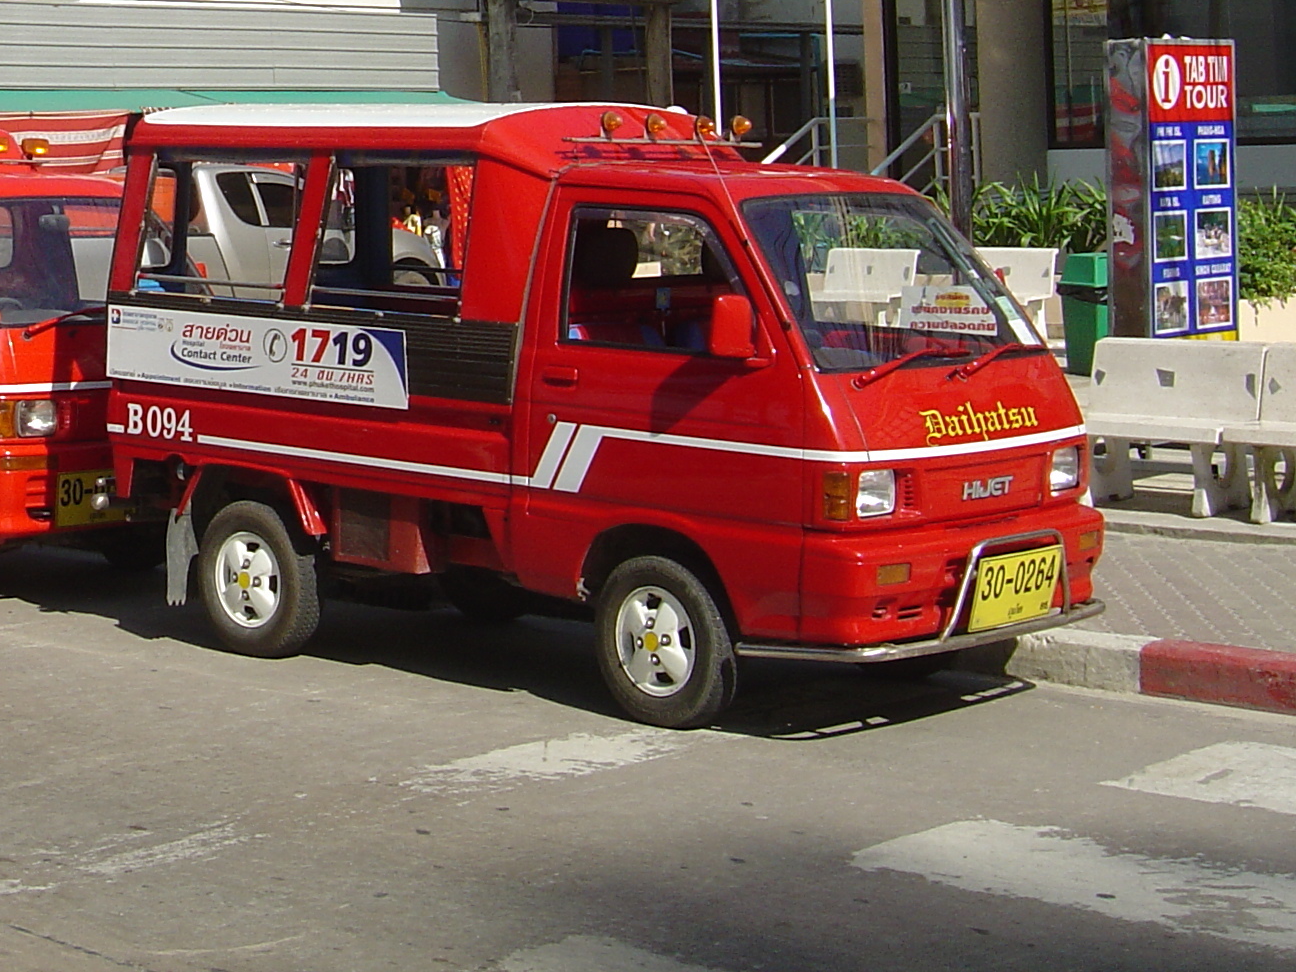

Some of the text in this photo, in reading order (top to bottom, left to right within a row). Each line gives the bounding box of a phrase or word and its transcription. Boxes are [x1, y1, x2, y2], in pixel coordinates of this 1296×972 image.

[1184, 55, 1228, 83] TAB TIM
[1184, 85, 1228, 109] TOUR
[182, 322, 252, 344] สายด่วน
[181, 347, 253, 364] Contact Center
[291, 327, 374, 368] 1719
[291, 367, 309, 379] 24
[333, 392, 375, 403] Ambulance
[127, 402, 194, 443] B 094
[919, 400, 1039, 447] Daihatsu
[962, 475, 1014, 501] HIJET
[980, 554, 1056, 602] 30-0264
